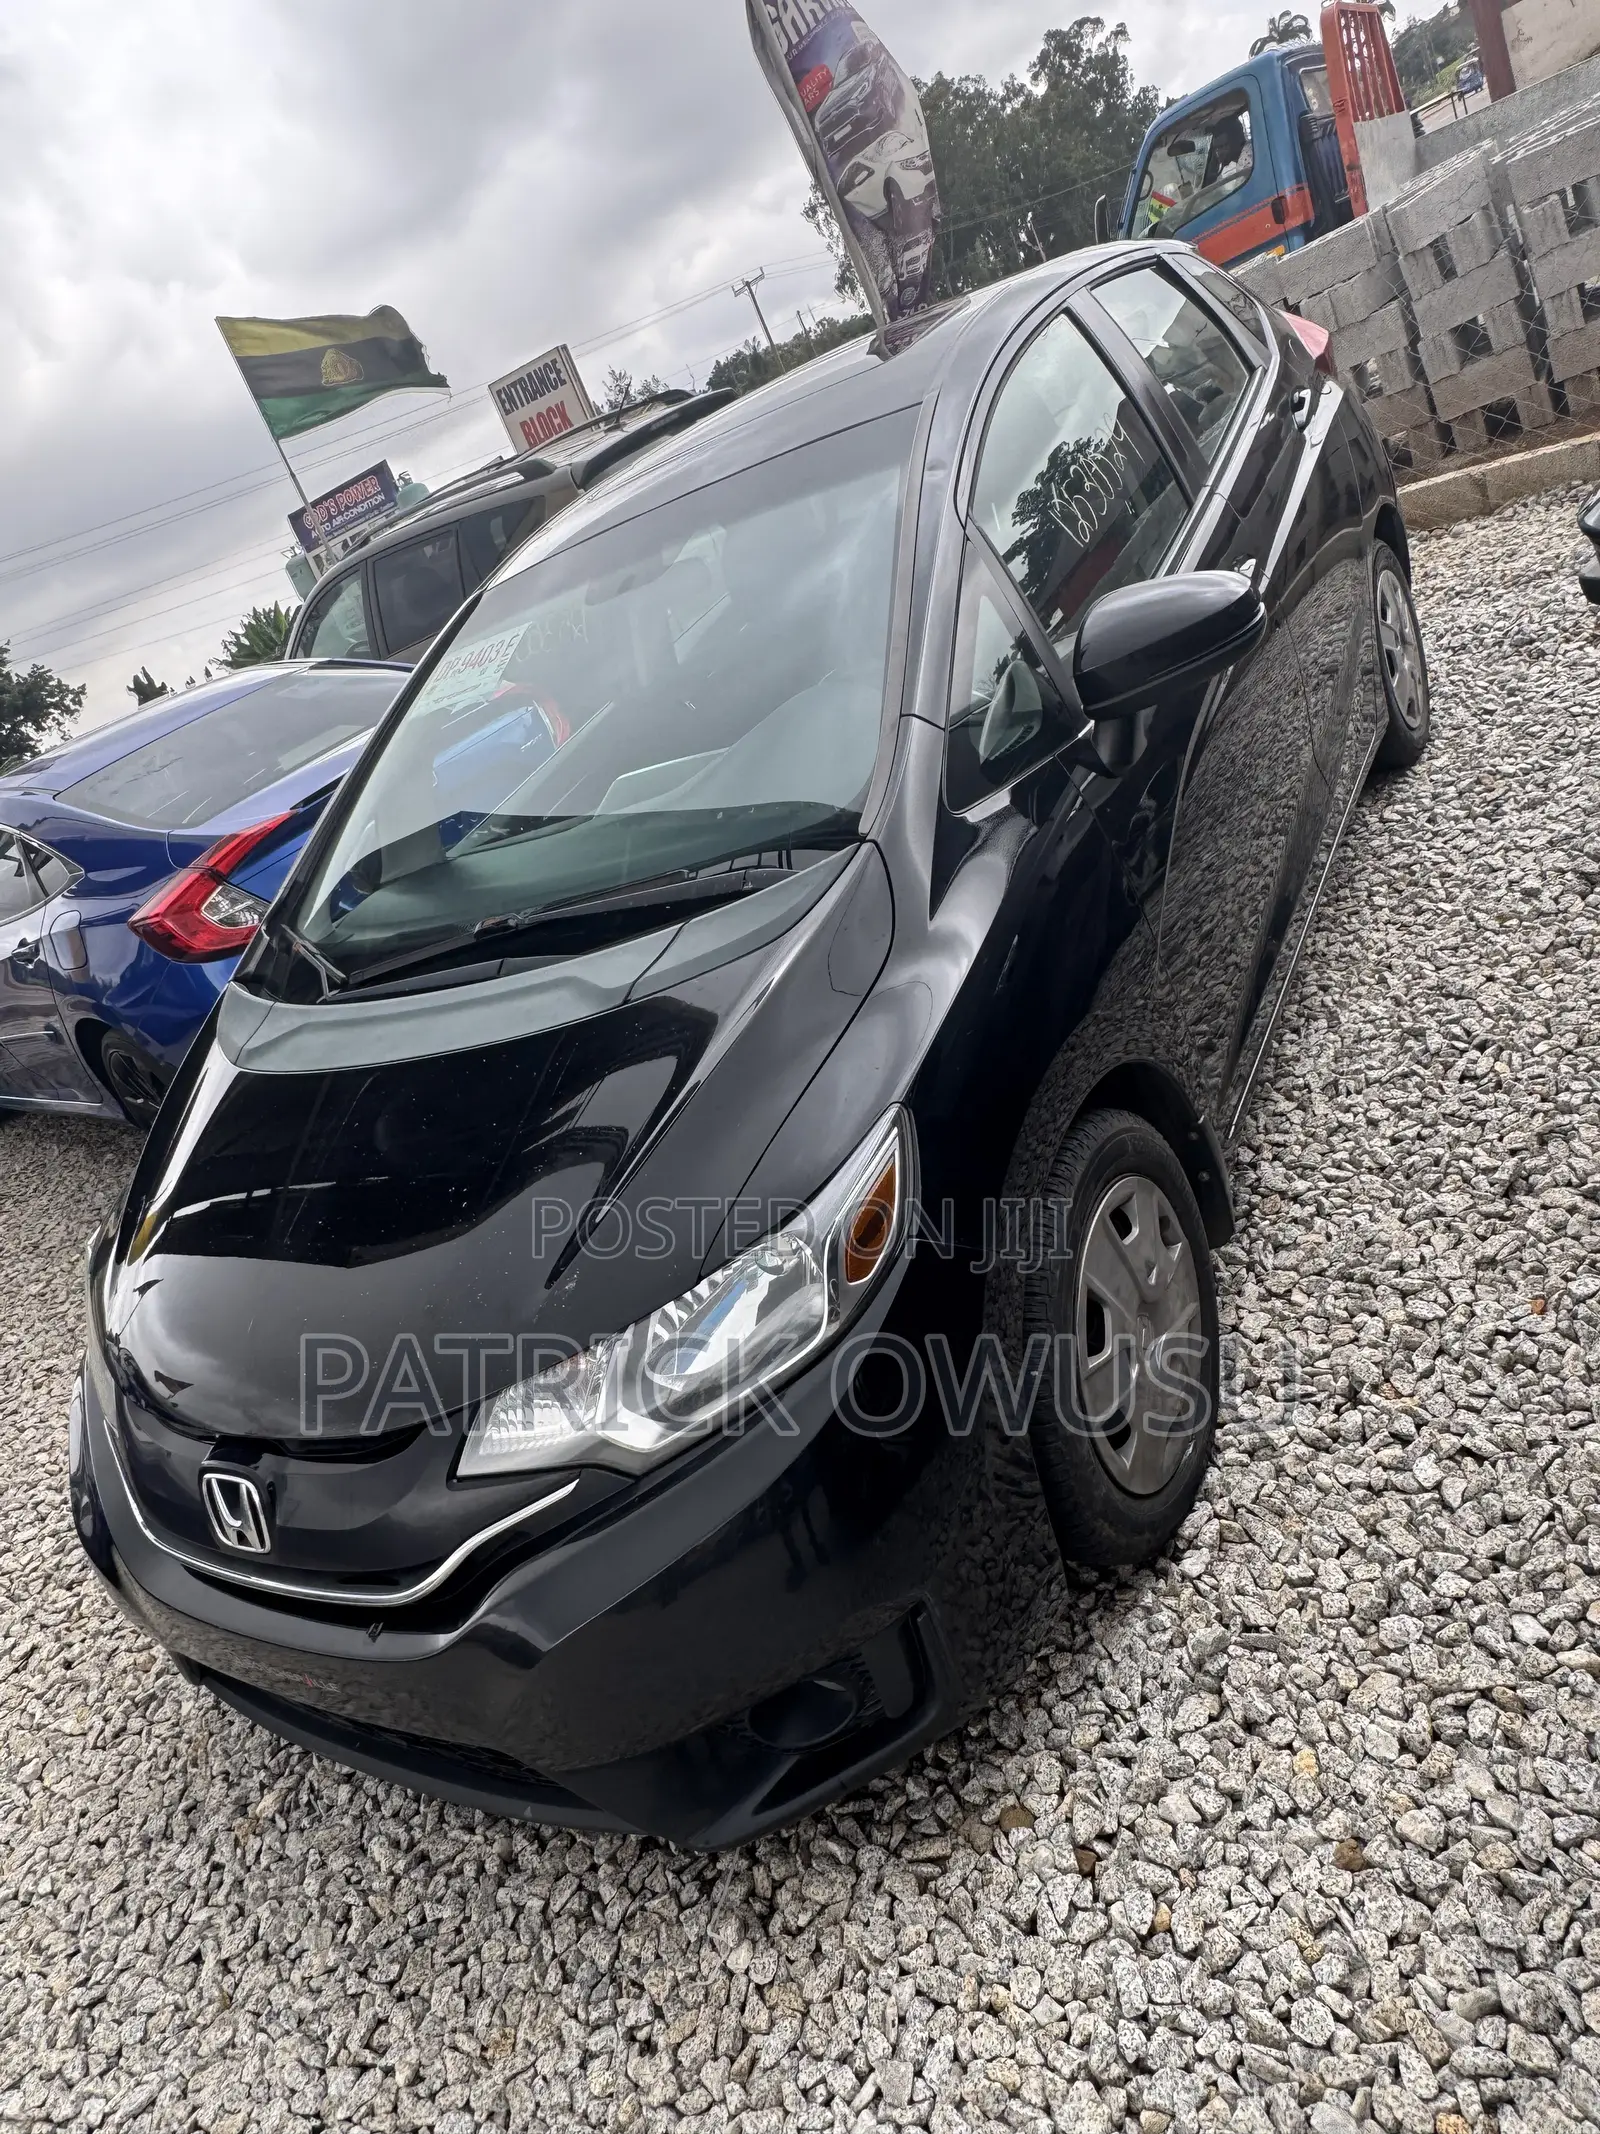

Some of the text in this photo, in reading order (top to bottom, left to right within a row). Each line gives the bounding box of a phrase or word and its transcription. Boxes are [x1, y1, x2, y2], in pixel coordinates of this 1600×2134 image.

[800, 67, 828, 98] UALITY
[804, 88, 820, 106] ARS
[496, 358, 567, 416] ENTRANCE
[519, 400, 574, 448] BLOCK
[336, 475, 381, 511] POWER
[311, 523, 331, 539] ATO
